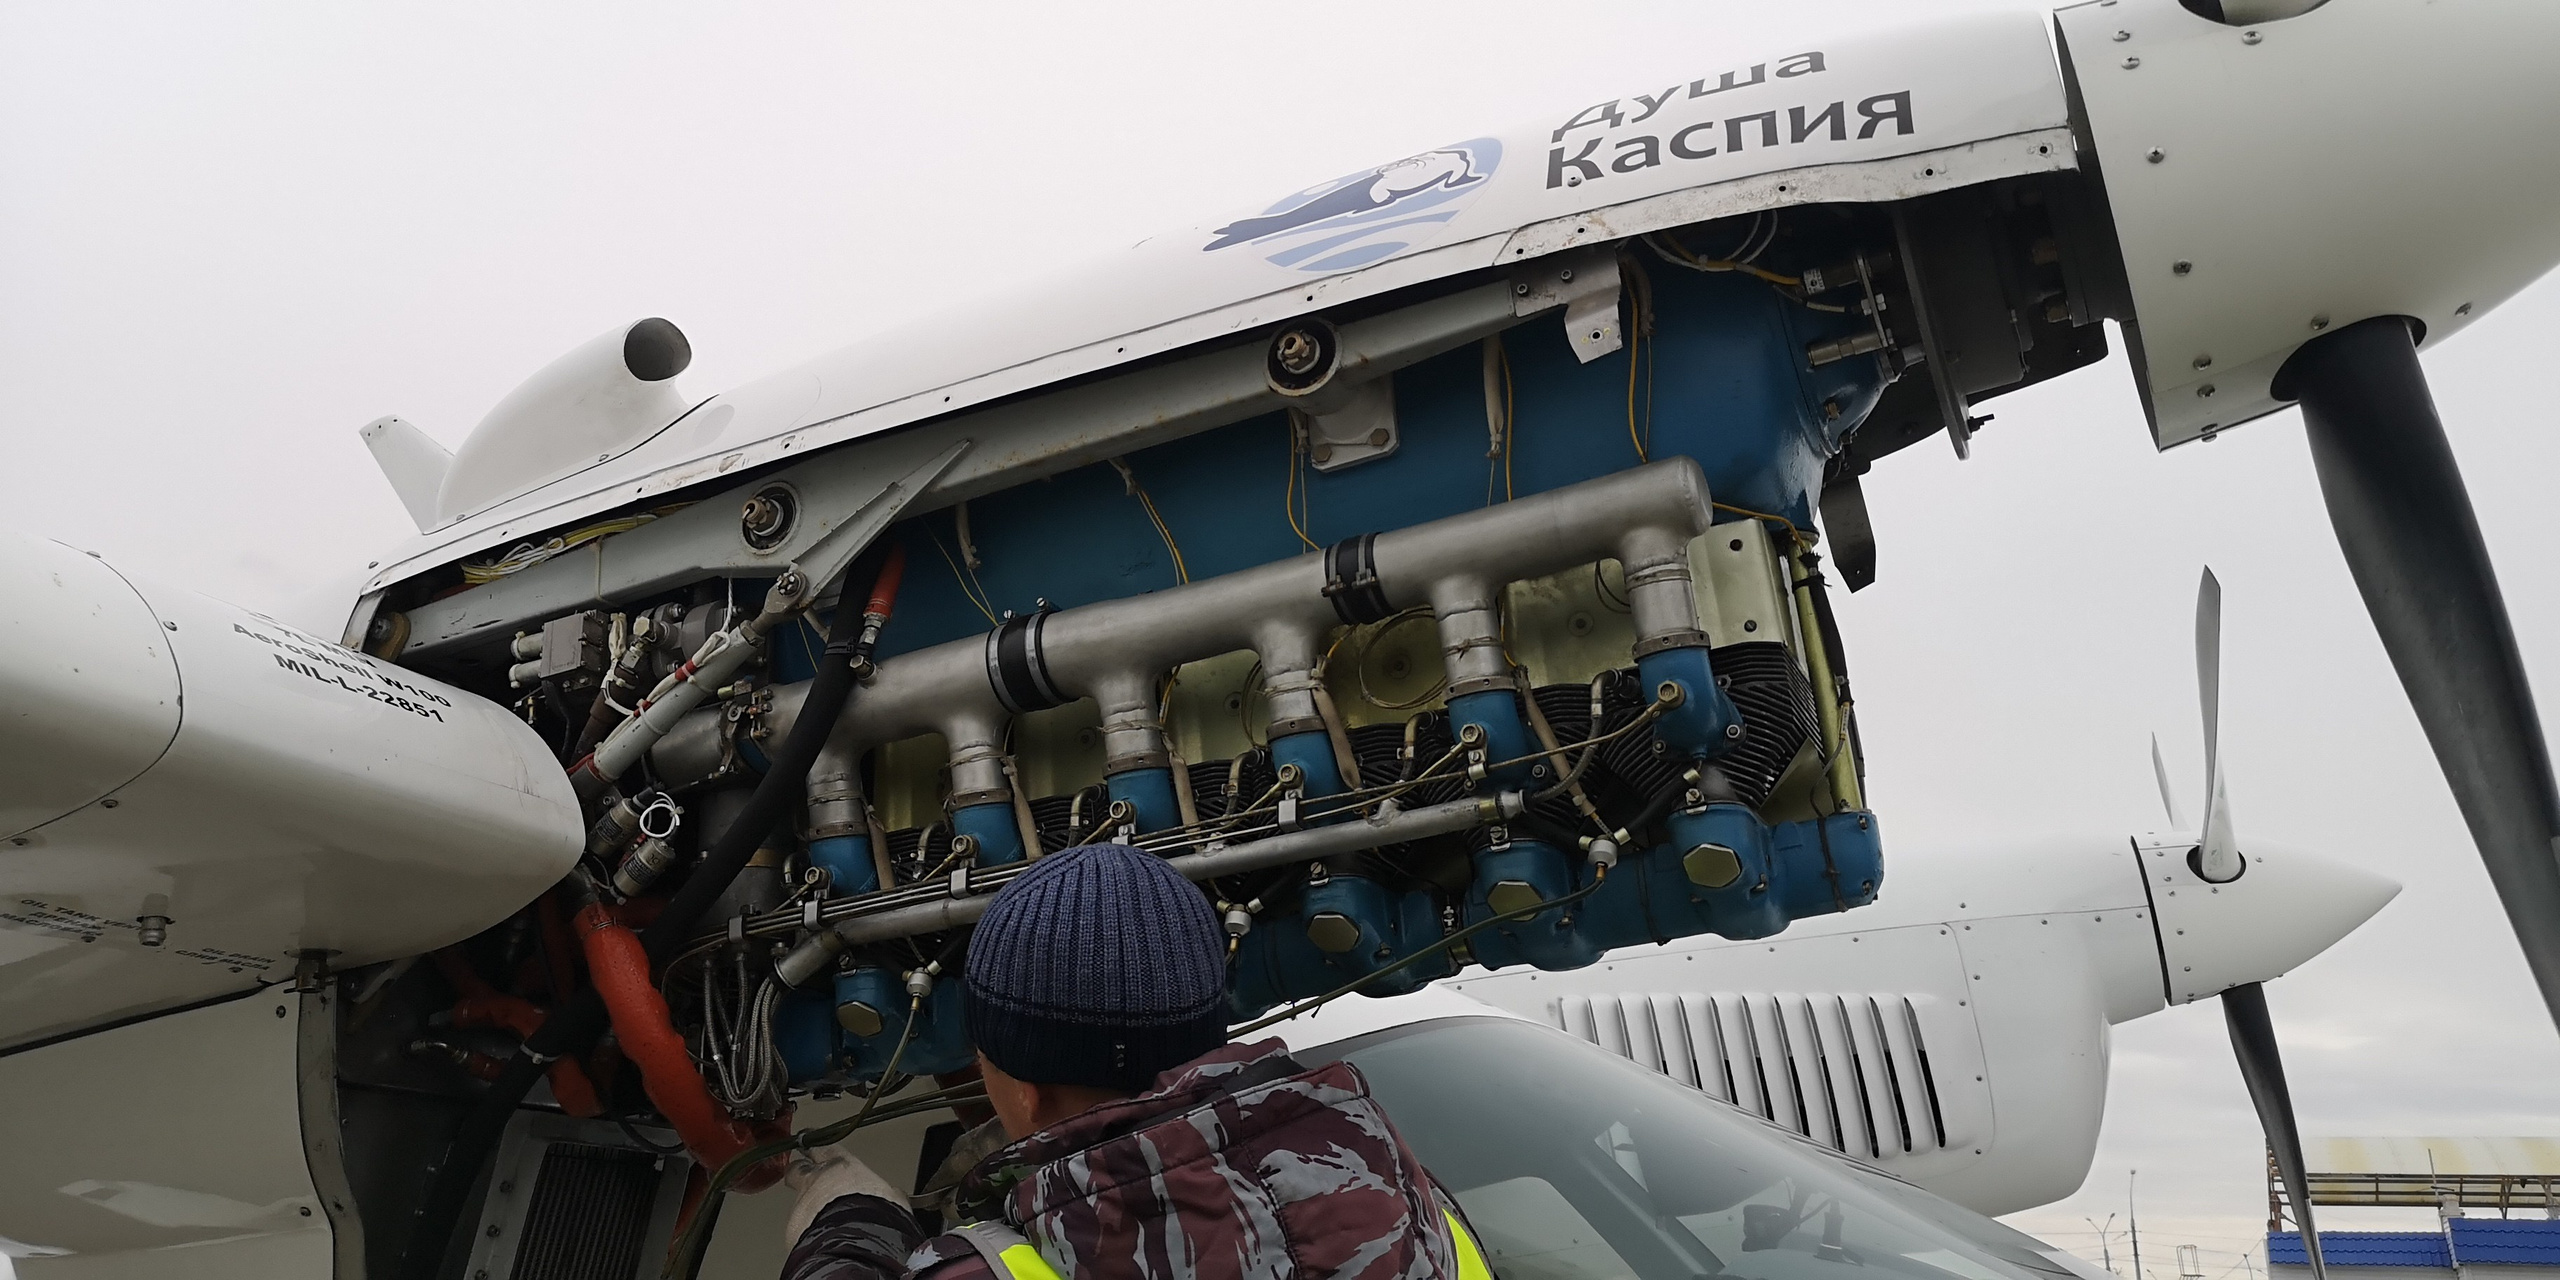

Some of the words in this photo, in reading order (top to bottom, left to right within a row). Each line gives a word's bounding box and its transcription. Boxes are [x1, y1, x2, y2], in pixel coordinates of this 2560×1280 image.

[1545, 90, 1915, 190] Каспия
[1551, 51, 1827, 144] Душа
[233, 623, 374, 680] AeroShell
[375, 673, 452, 708] W100
[273, 653, 445, 723] MIL-L-22851
[20, 899, 49, 909] OIL
[55, 906, 101, 922] TANK
